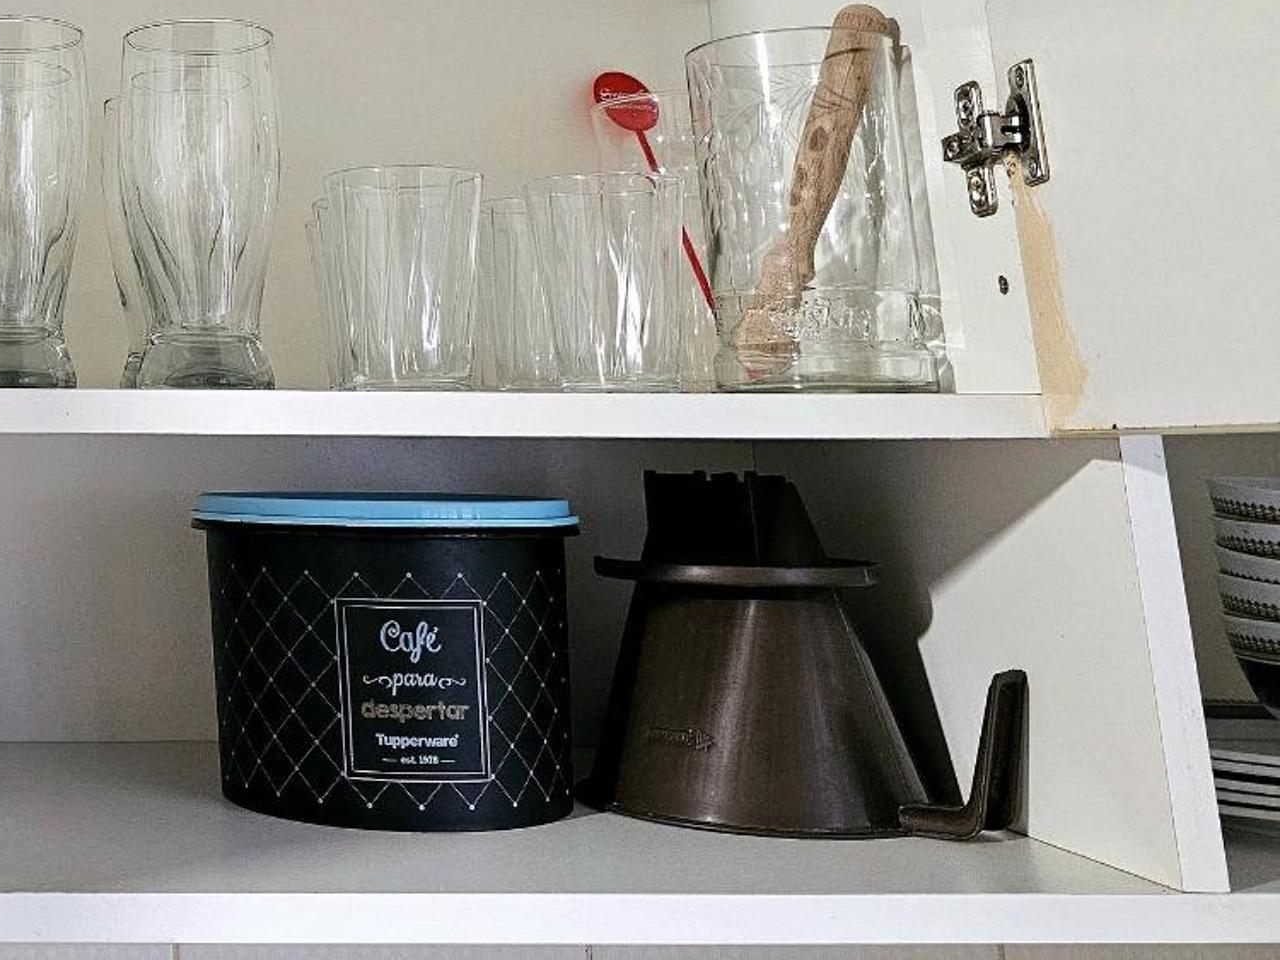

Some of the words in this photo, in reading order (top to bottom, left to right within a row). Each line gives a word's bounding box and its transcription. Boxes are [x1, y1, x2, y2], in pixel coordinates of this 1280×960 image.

[379, 619, 442, 664] Café
[390, 672, 439, 697] para
[360, 700, 470, 724] despertar
[375, 732, 460, 749] Tupperware
